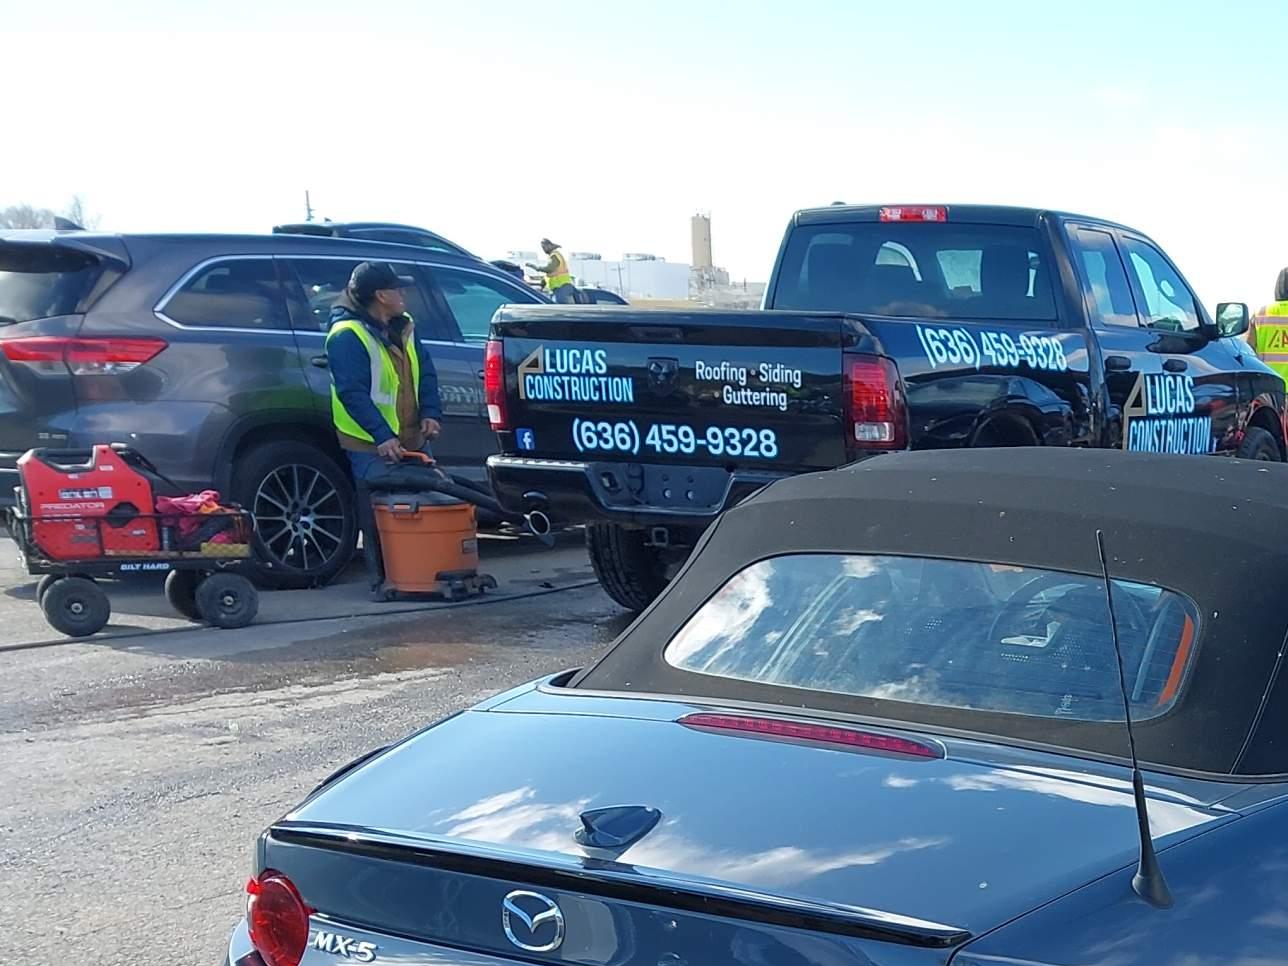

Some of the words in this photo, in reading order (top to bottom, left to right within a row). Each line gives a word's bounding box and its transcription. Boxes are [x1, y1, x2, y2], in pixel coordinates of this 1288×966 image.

[915, 324, 981, 370] (636)
[980, 331, 1068, 371] 459-9328
[544, 349, 607, 374] LUCAS
[695, 361, 747, 386] Roofing
[758, 363, 802, 388] Siding
[525, 375, 633, 402] CONSTRUCTION
[722, 385, 787, 411] Guttering
[1145, 375, 1195, 414] LUCAS
[572, 417, 640, 455] (636)
[645, 423, 778, 458] 459-9328
[1128, 416, 1212, 453] CONSTRUCTION
[39, 502, 105, 510] PREDATOR
[142, 562, 170, 570] HARD
[313, 931, 377, 962] MX-5
